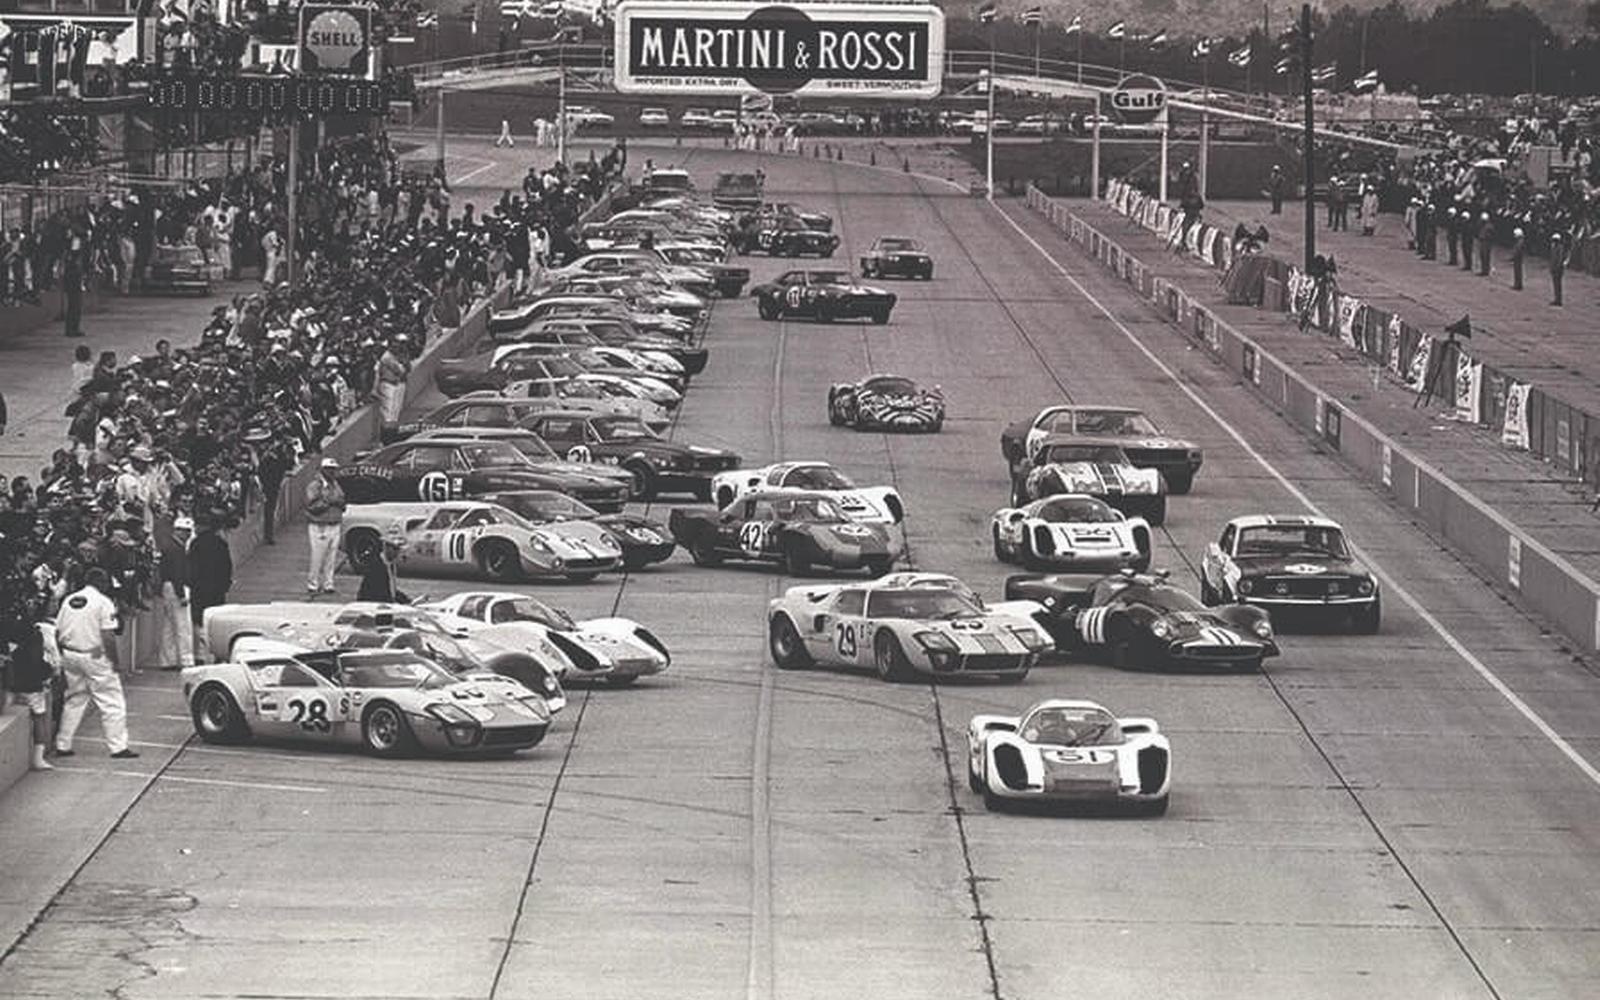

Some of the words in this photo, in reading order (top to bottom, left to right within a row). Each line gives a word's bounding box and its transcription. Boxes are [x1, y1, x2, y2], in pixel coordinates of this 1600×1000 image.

[311, 31, 357, 46] SHELL
[640, 28, 786, 69] MARTINI
[794, 40, 811, 69] &
[818, 30, 917, 71] ROSSI
[685, 77, 717, 86] EXTRA
[1113, 91, 1164, 107] Gulf
[423, 476, 447, 501] 15
[449, 531, 466, 562] 10
[740, 523, 761, 552] 42
[836, 621, 858, 658] 29
[287, 698, 332, 734] 28
[1055, 750, 1099, 762] 51
